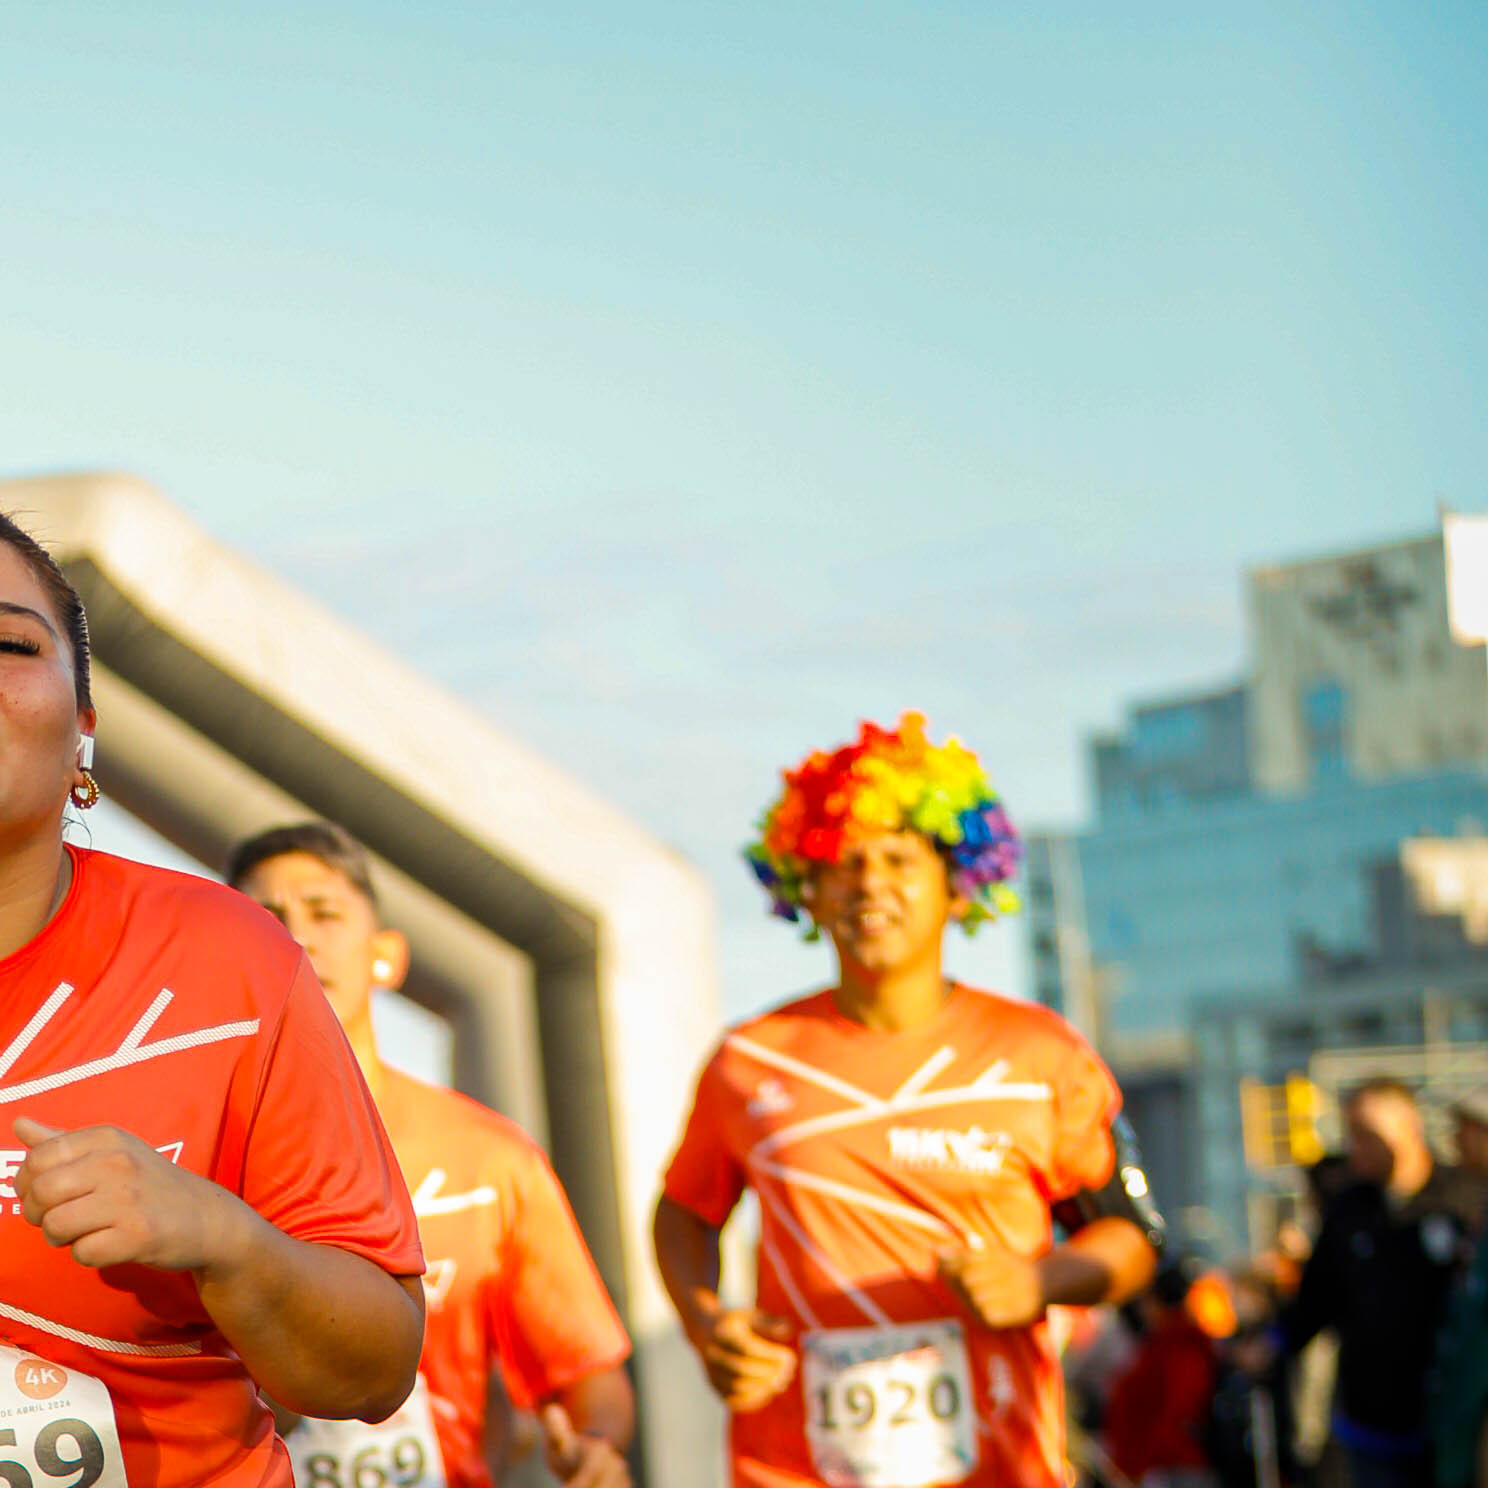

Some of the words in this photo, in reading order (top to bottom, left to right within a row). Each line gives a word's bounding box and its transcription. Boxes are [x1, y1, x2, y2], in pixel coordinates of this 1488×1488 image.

[25, 1366, 59, 1387] 4K
[816, 1372, 960, 1429] 1920
[1, 1410, 12, 1418] DE
[16, 1405, 44, 1415] ABRIL
